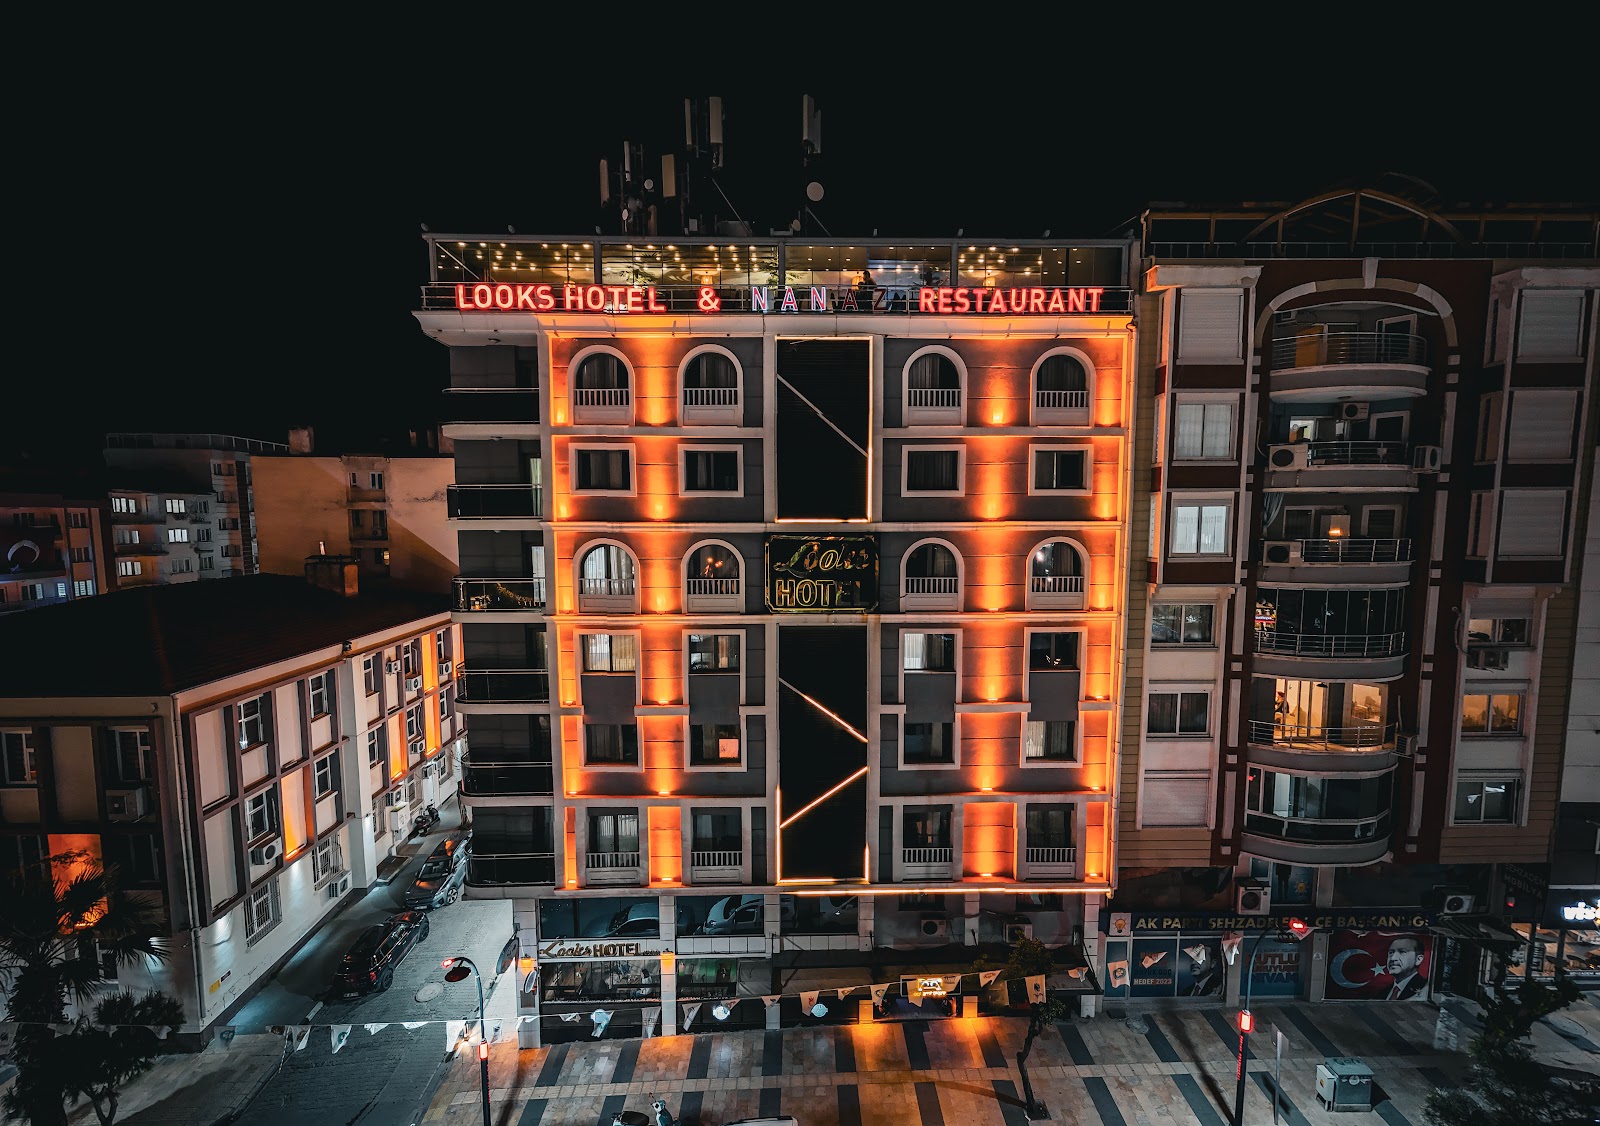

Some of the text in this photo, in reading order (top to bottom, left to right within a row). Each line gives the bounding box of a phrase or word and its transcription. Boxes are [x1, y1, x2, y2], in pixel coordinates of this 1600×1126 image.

[456, 284, 554, 311] LOOKS
[565, 285, 666, 312] HOTEL
[697, 286, 721, 312] &
[919, 286, 1104, 313] RESTAURANT
[773, 541, 869, 578] Looks
[776, 579, 870, 606] HOTEL
[1136, 917, 1158, 929] AK
[593, 942, 641, 957] HOTEL
